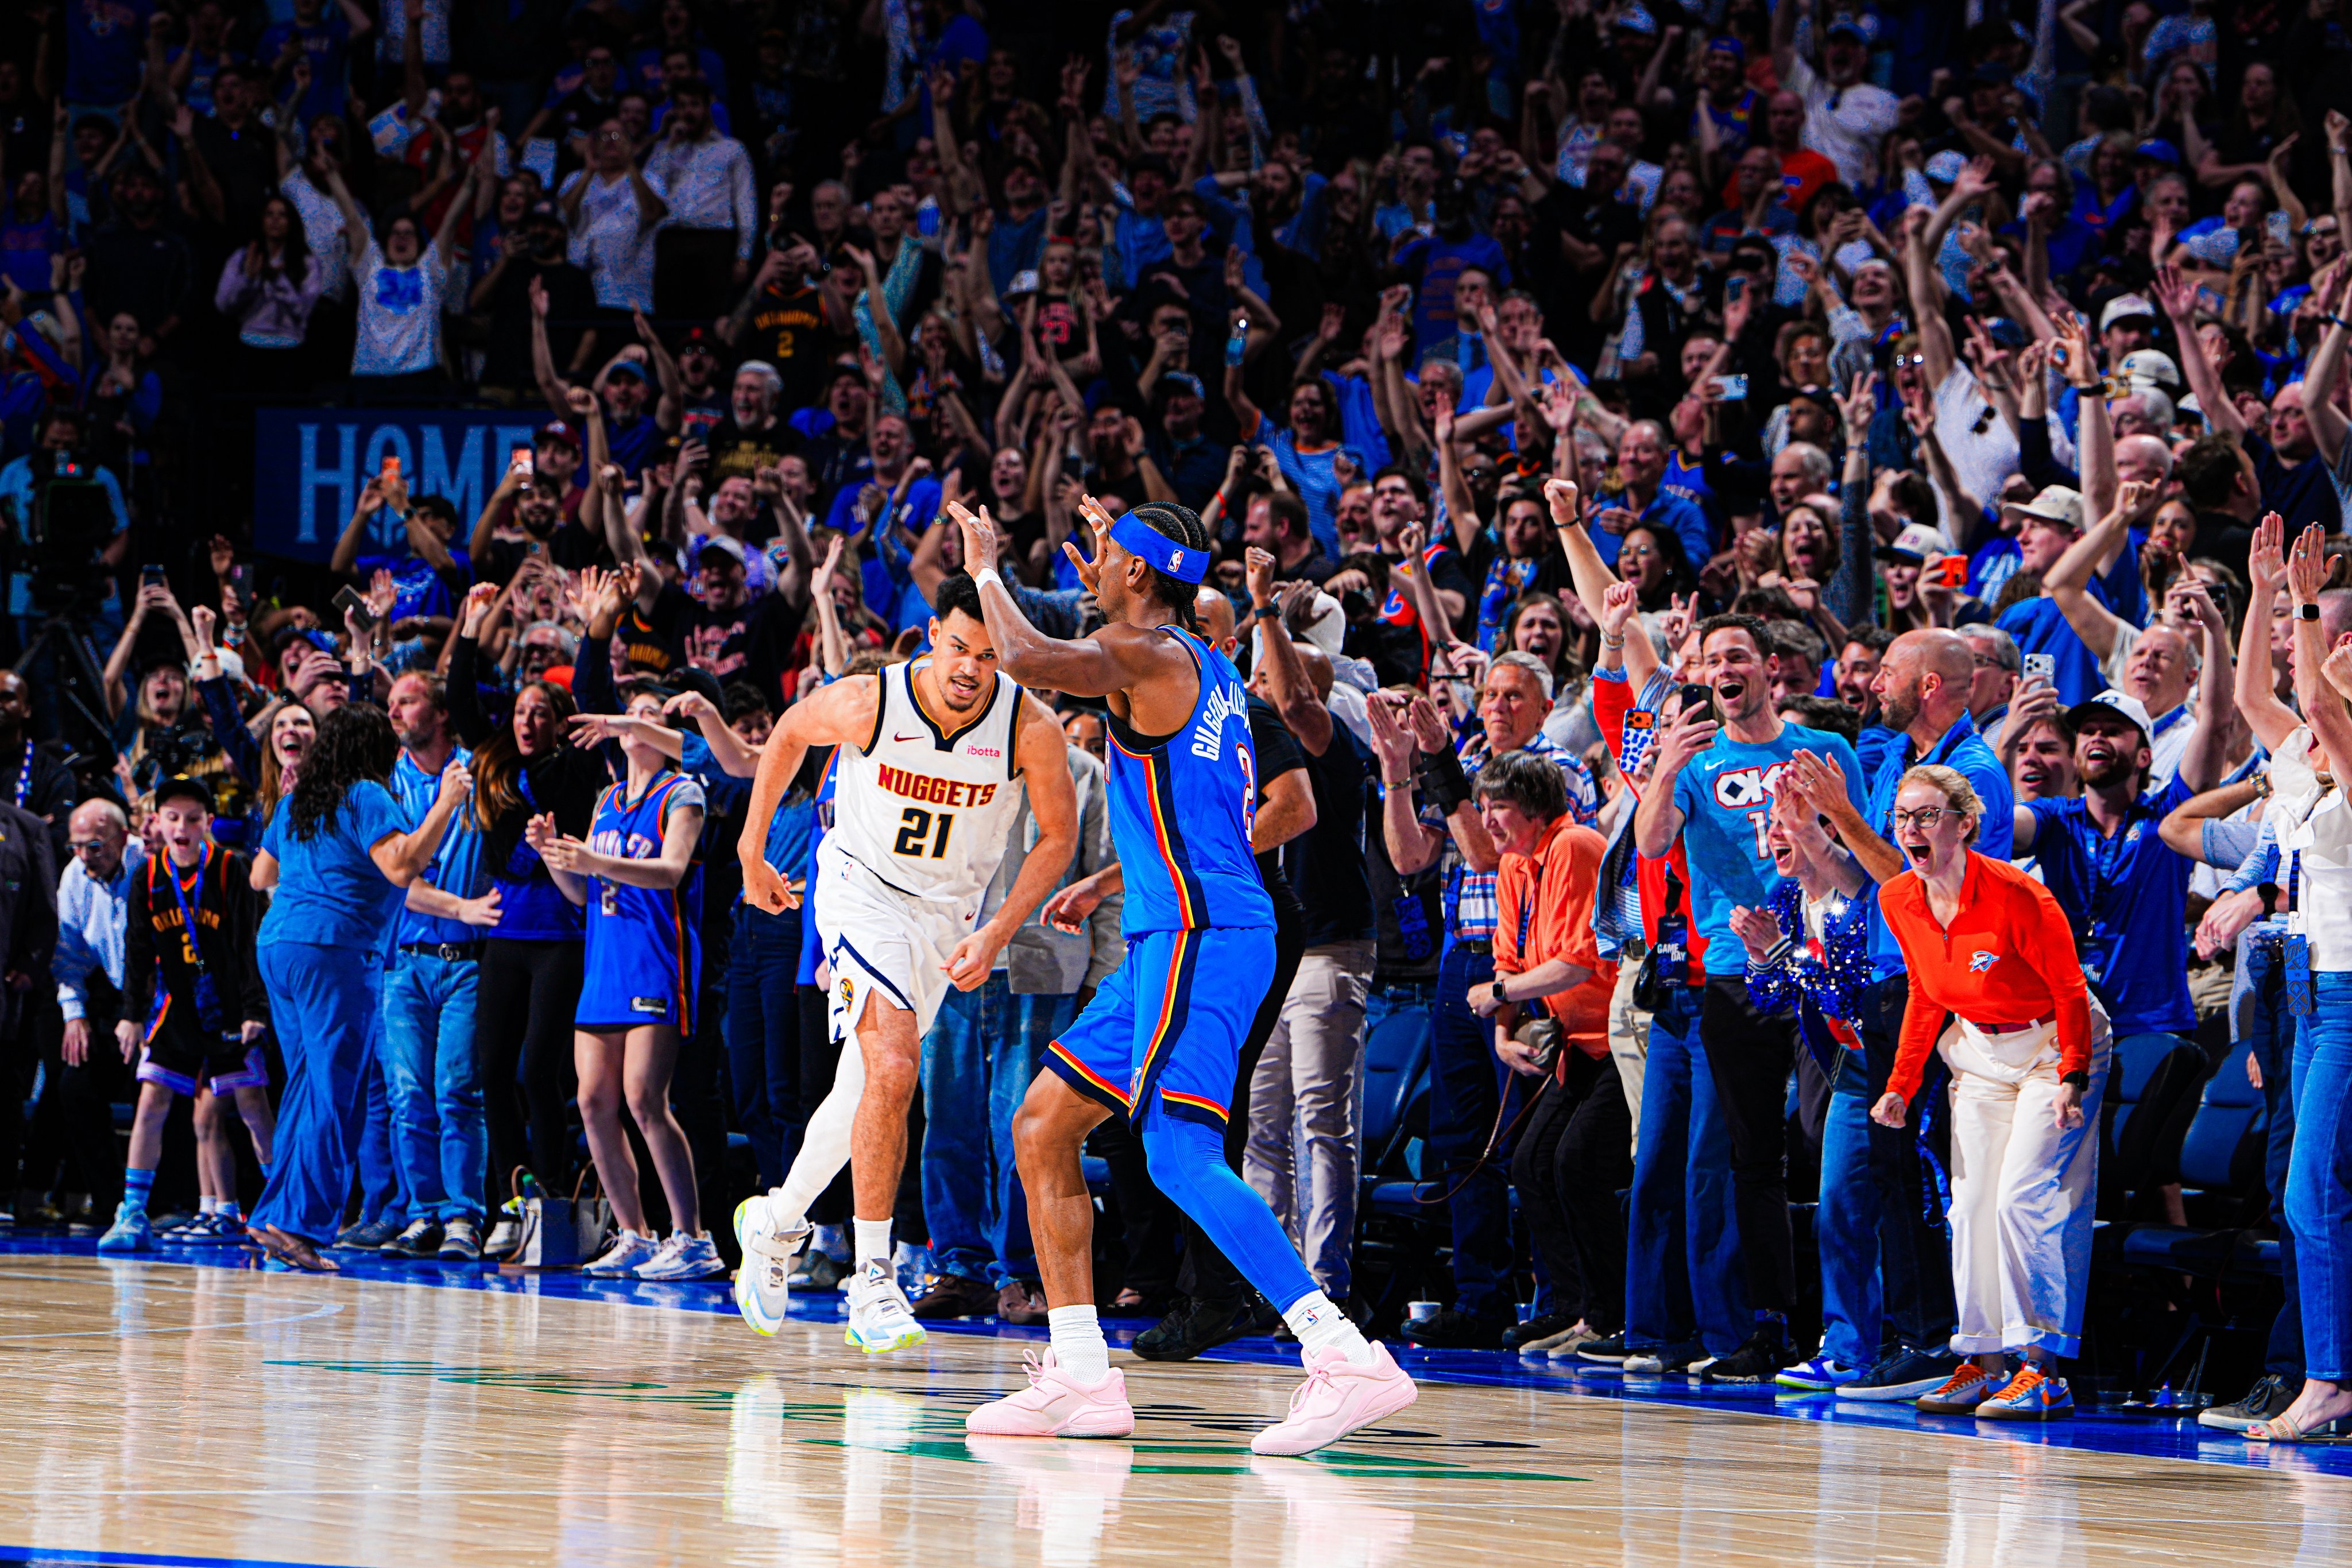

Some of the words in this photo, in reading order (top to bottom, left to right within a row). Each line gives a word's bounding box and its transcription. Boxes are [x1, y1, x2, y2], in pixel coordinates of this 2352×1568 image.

[967, 745, 1000, 758] ibotta
[877, 762, 998, 808] NUGGETS
[1712, 761, 1798, 810] OK
[892, 806, 956, 860] 21
[2289, 850, 2300, 896] UNDER
[151, 905, 220, 933] OKLAMA
[1657, 942, 1680, 954] GAME
[1671, 950, 1687, 962] DAY
